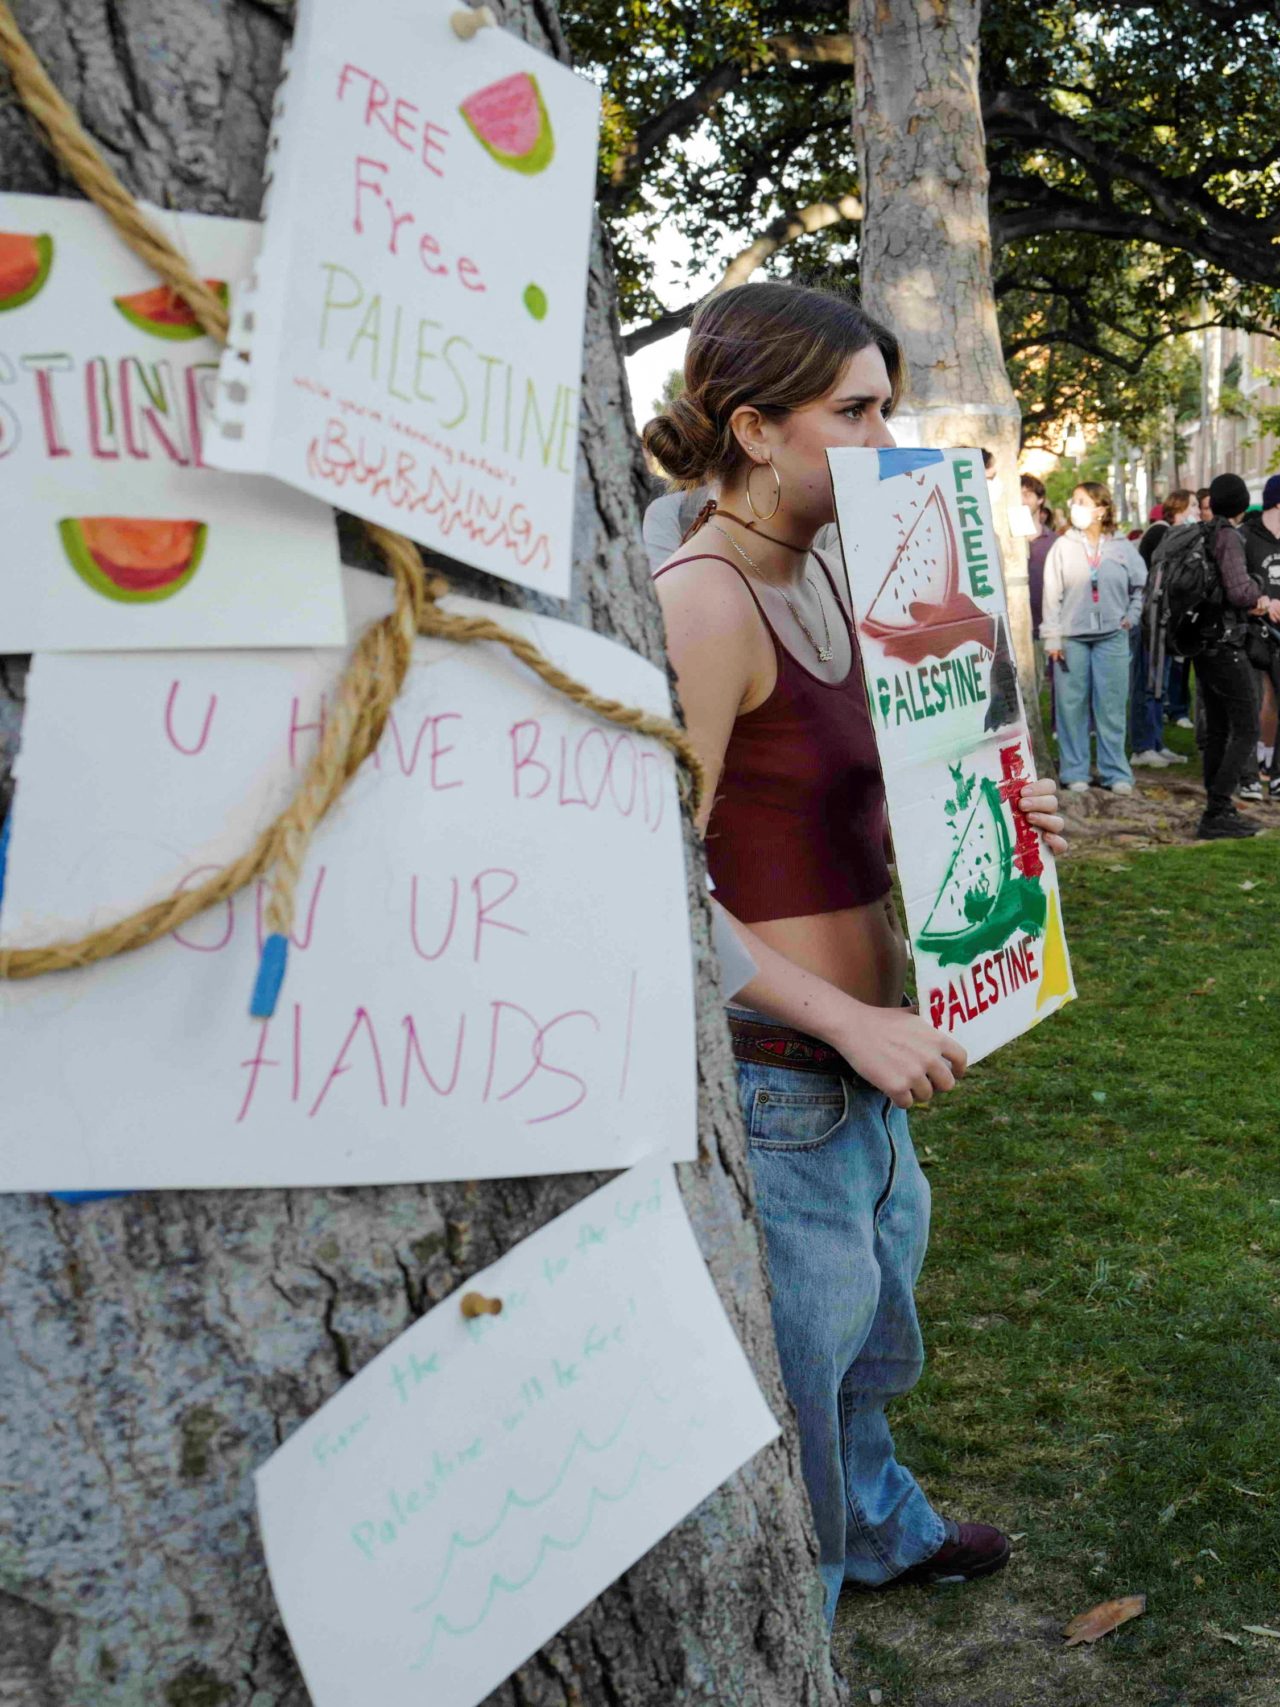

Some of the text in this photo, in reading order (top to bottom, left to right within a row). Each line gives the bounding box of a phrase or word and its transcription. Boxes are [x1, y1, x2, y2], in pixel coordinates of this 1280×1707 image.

[336, 63, 449, 177] FREE
[353, 155, 487, 292] Free
[319, 262, 578, 475] PALESTINE
[322, 416, 533, 546] BURNING
[952, 460, 995, 597] FREE
[876, 653, 987, 729] PALESTINE
[165, 680, 664, 833] U HVE BLOOD
[410, 868, 528, 961] UR
[929, 935, 1039, 1033] PALESTINE
